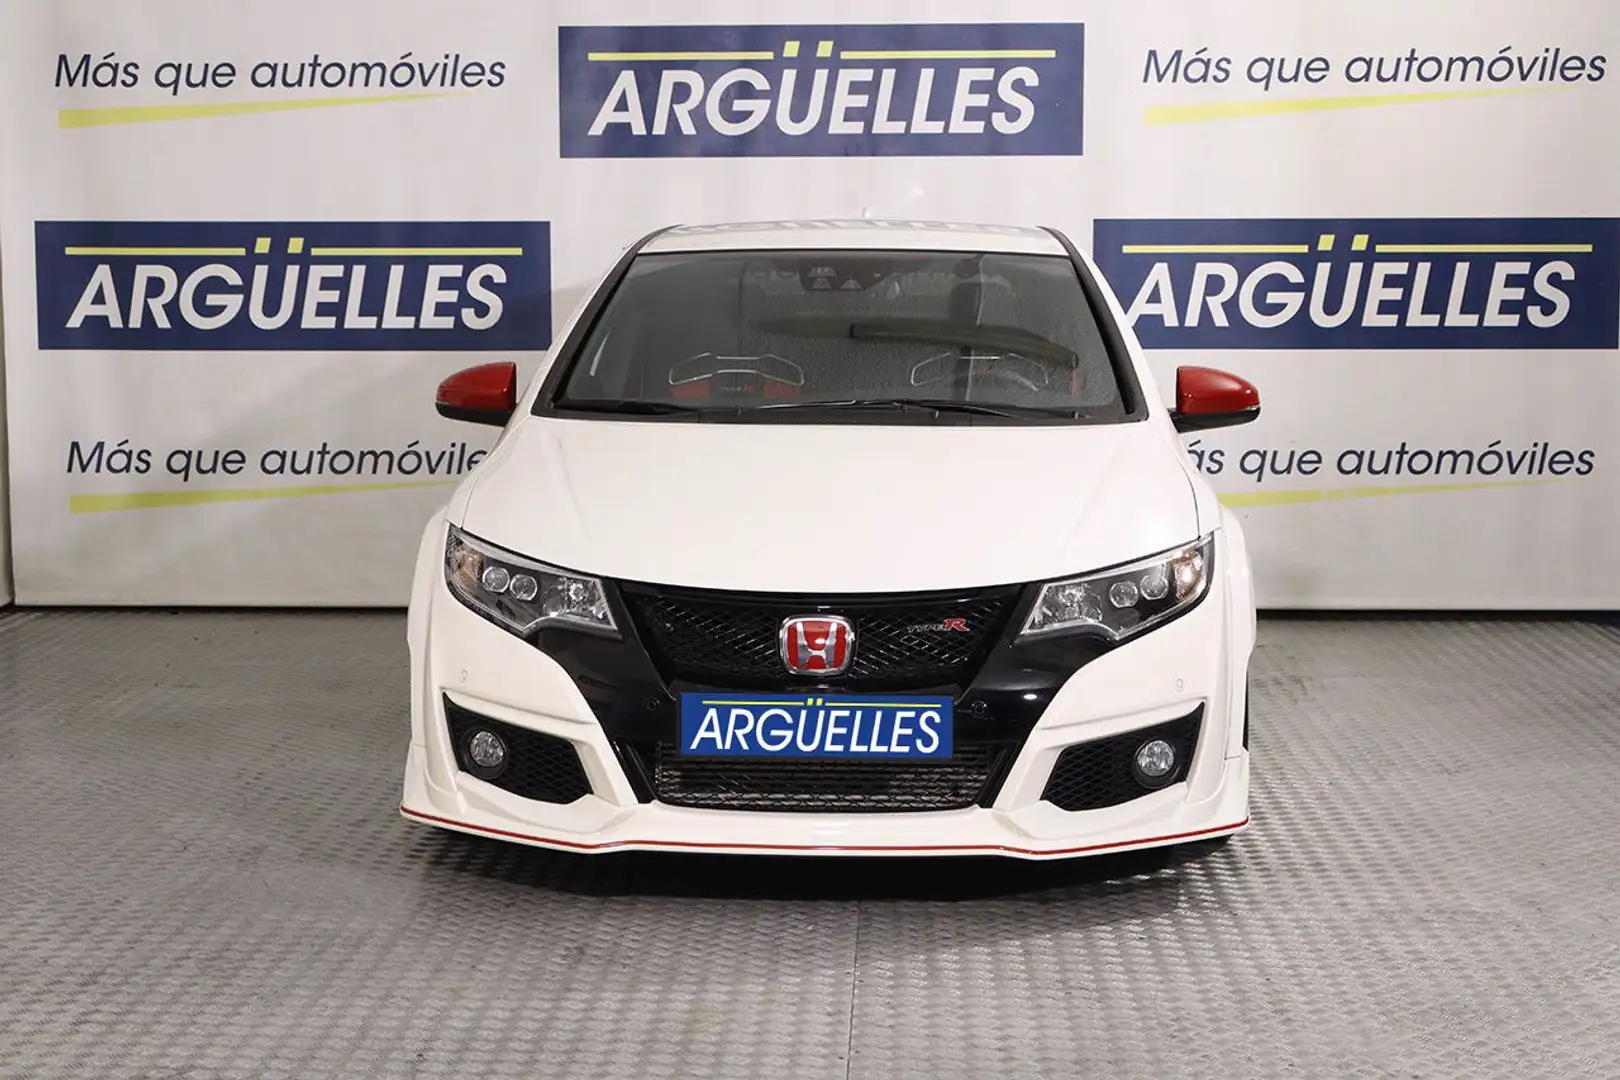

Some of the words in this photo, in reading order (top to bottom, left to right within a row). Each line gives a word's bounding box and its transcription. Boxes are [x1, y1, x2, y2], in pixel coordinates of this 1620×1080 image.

[55, 52, 140, 88] Más
[154, 62, 236, 96] que
[250, 52, 506, 89] automóviles
[588, 41, 1040, 136] ARGÜELLES
[1143, 47, 1232, 84] Más
[1246, 57, 1330, 91] que
[1345, 46, 1607, 83] automóviles
[66, 237, 507, 330] ARGÜELLES
[1127, 234, 1576, 329] ARGÜELLES
[67, 439, 152, 475] Más
[166, 449, 247, 482] que
[260, 440, 488, 475] automóvile
[1187, 439, 1226, 475] ás
[1240, 449, 1323, 483] que
[1336, 440, 1596, 476] automóviles
[690, 697, 942, 754] ARGÜELLES
